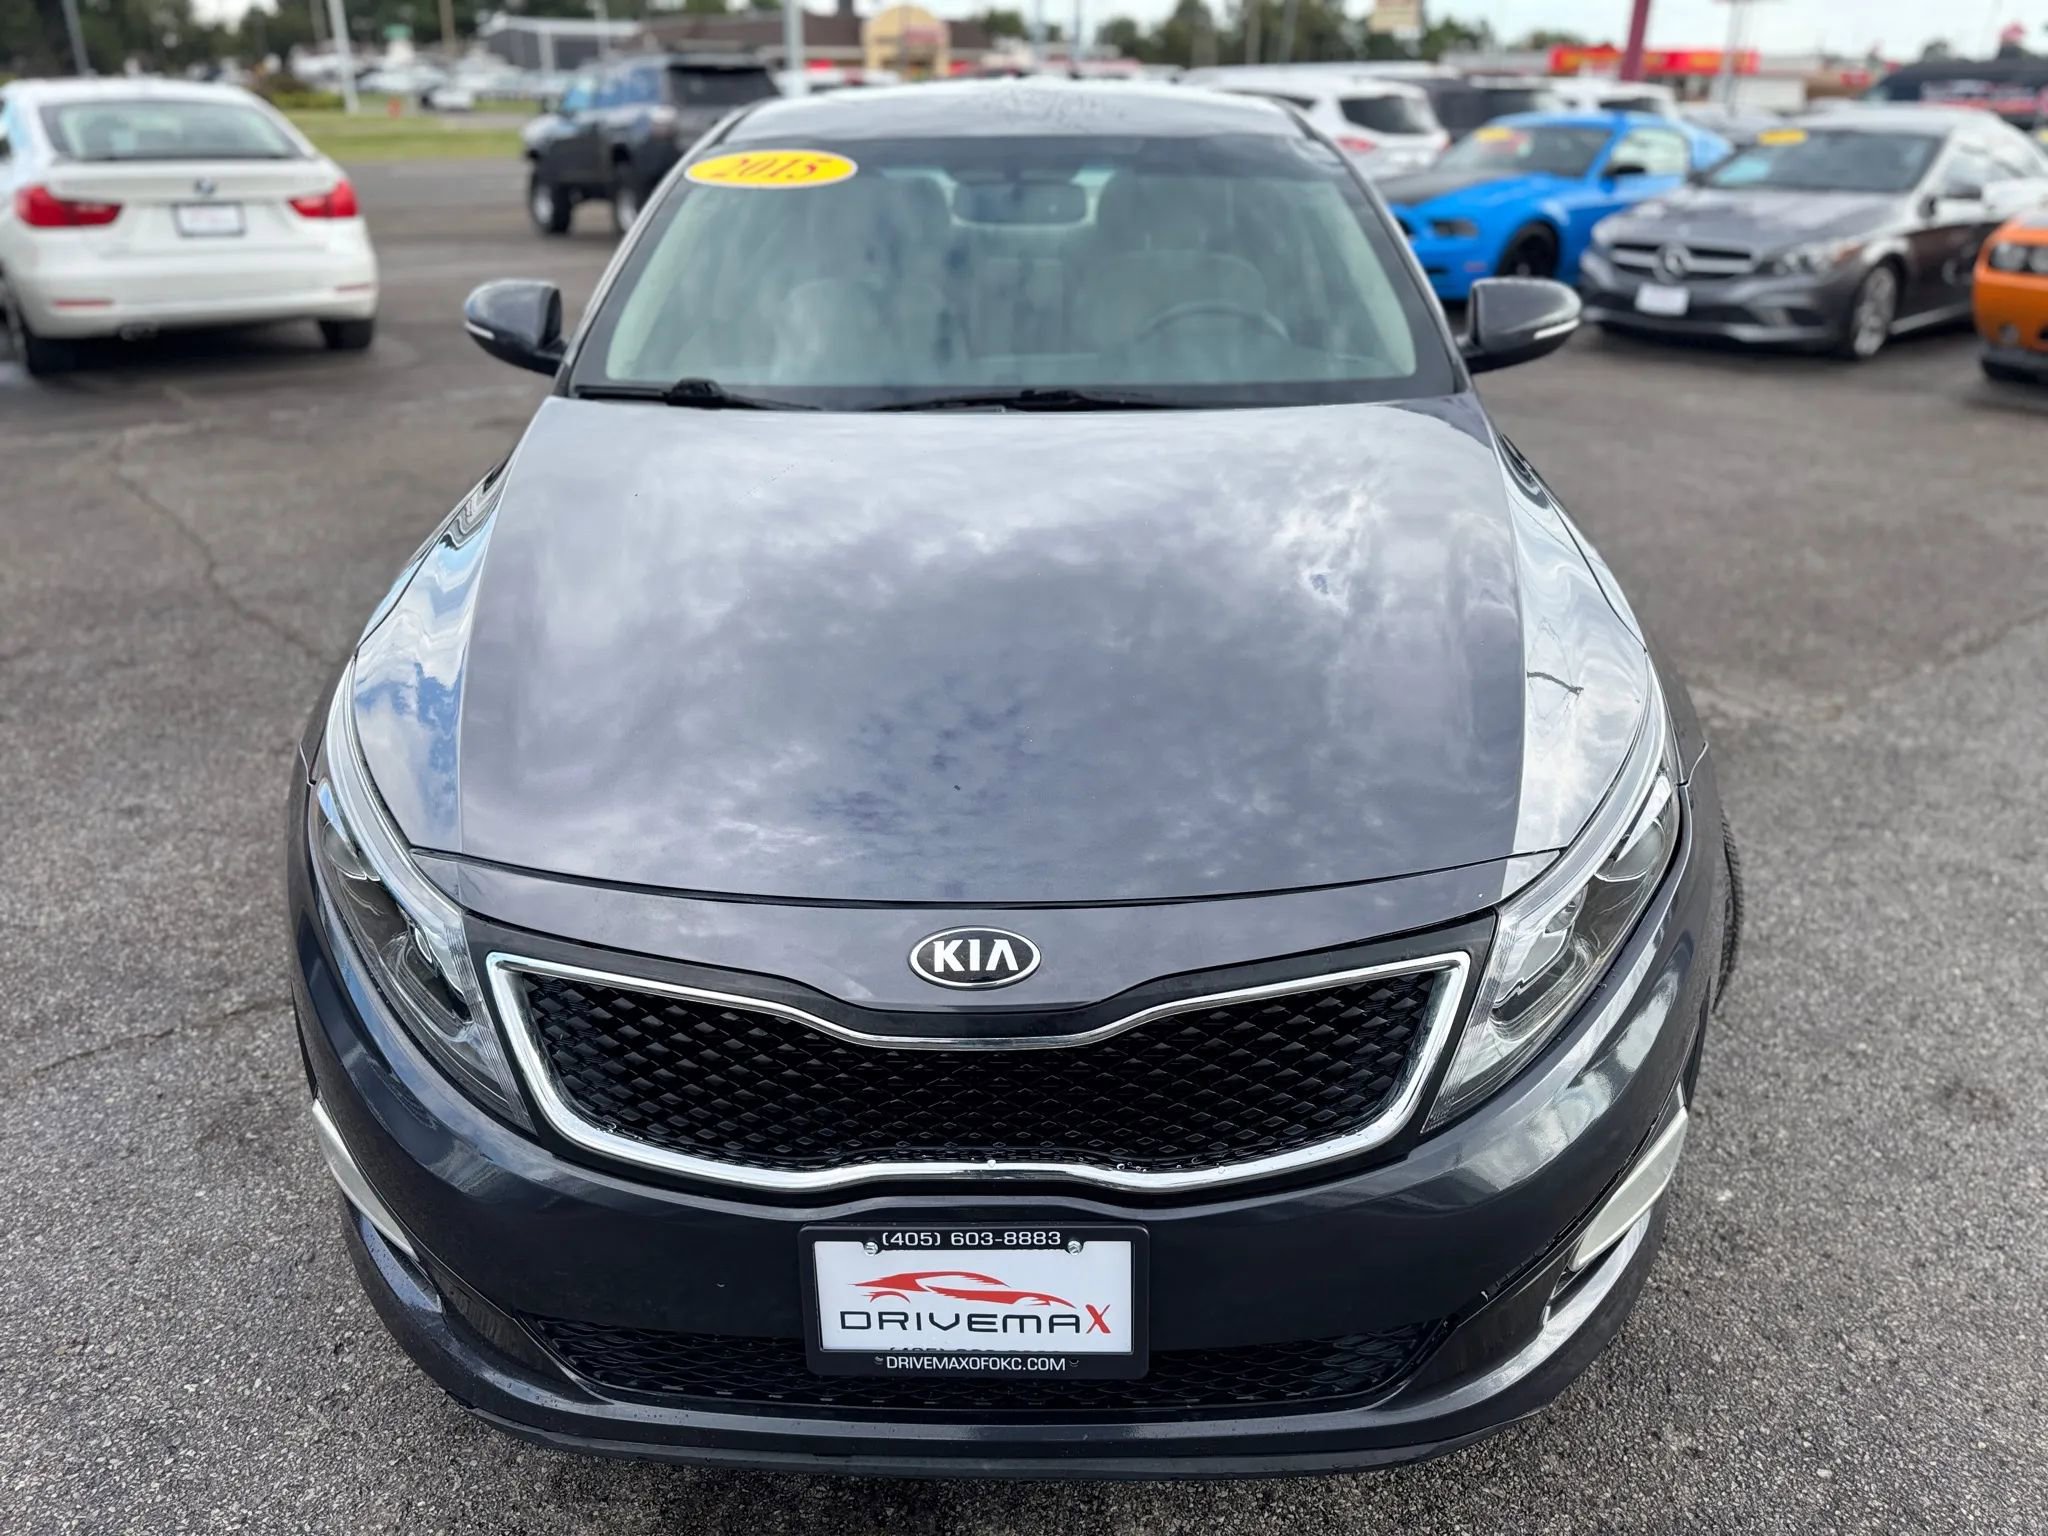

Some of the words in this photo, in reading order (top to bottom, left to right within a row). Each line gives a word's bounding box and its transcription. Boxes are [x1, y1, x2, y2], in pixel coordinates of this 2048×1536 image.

[709, 157, 833, 179] 2015
[933, 938, 1019, 973] KIA
[882, 1232, 941, 1247] (405)
[950, 1231, 1062, 1246] 603-8883
[839, 1303, 1112, 1334] DRIVEMAX
[886, 1356, 1066, 1371] DRIVEMAXOFOKC.COM
